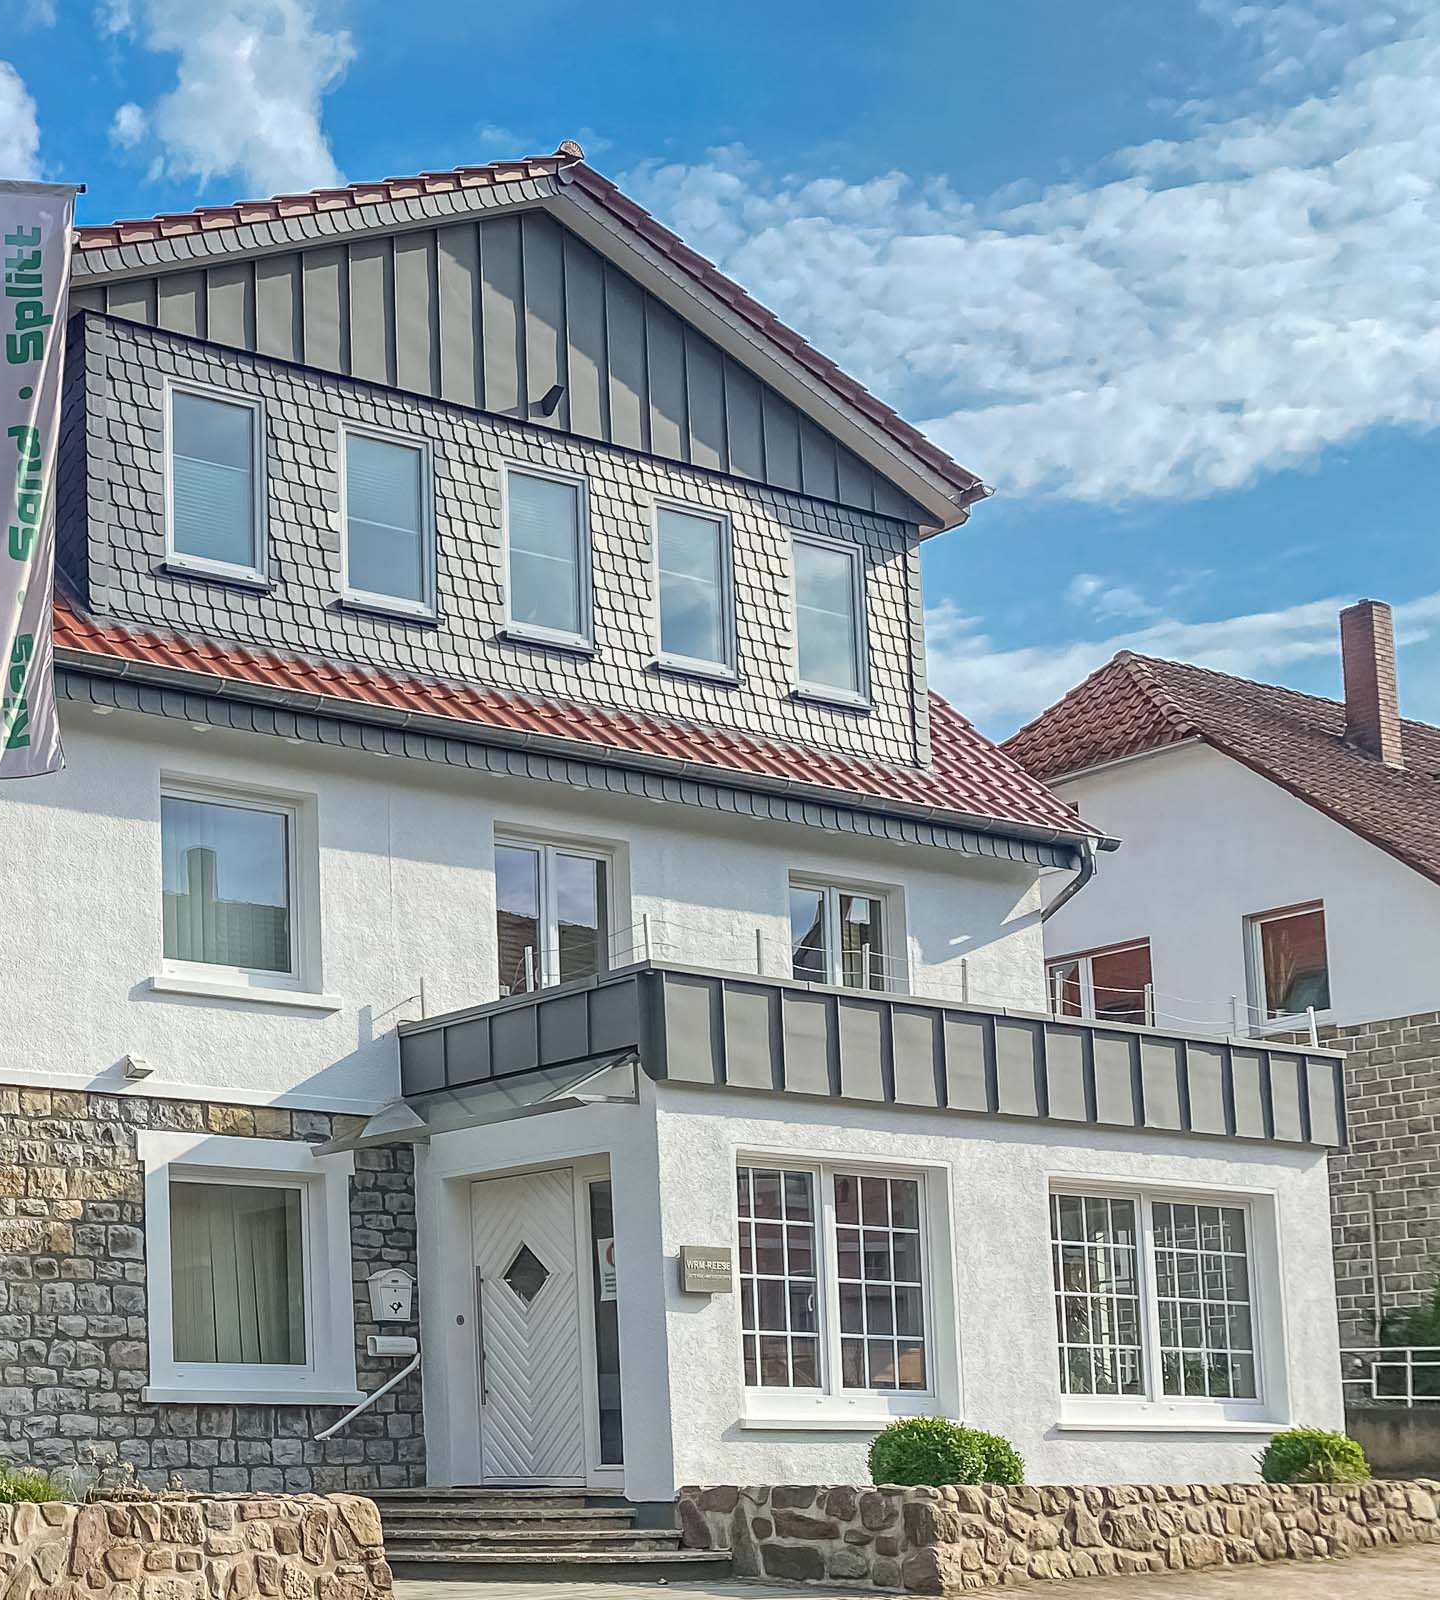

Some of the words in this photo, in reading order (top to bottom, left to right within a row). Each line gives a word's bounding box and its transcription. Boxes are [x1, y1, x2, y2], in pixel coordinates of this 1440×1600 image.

[3, 225, 54, 365] Splitt
[8, 425, 43, 561] Sand
[2, 633, 34, 749] Kies
